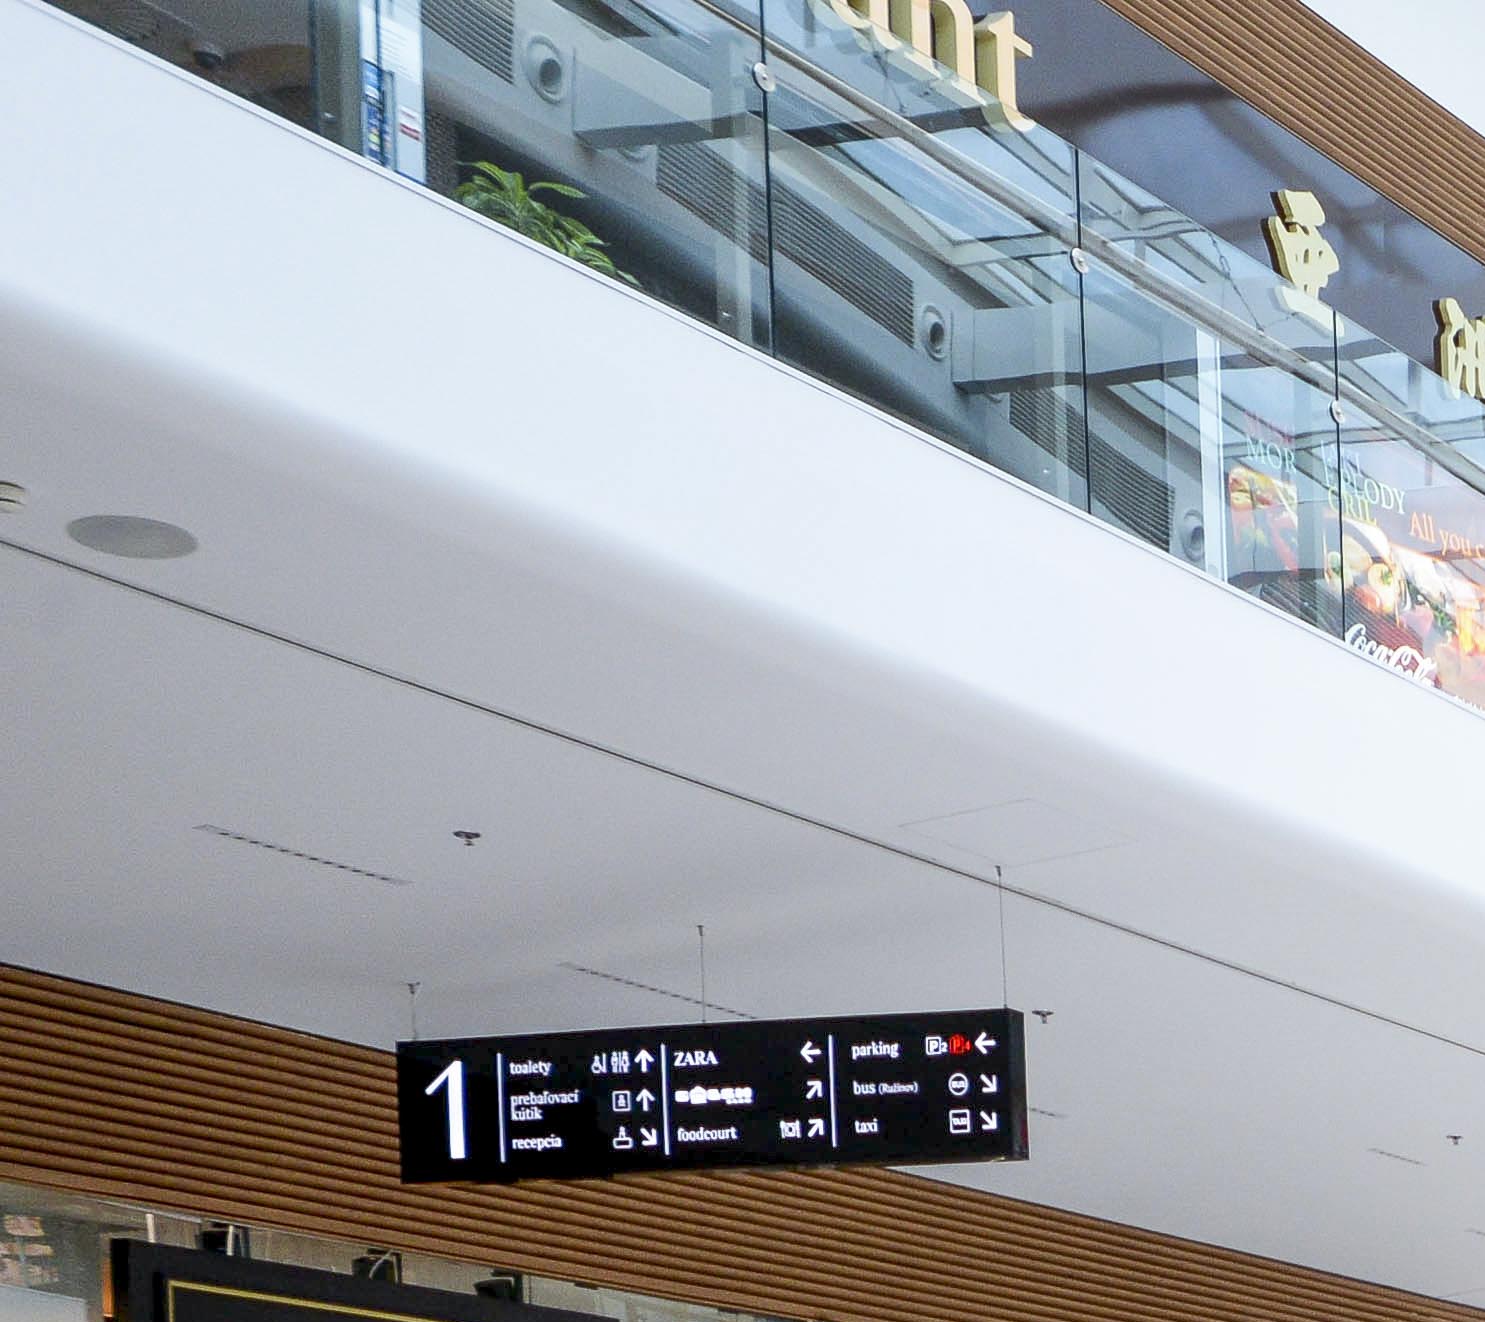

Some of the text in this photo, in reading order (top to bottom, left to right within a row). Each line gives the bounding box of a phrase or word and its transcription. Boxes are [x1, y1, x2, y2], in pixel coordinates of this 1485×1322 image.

[1409, 511, 1437, 544] All
[1439, 527, 1472, 558] you
[673, 1050, 718, 1067] ZARA
[852, 1040, 899, 1060] parking
[509, 1060, 552, 1077] toalety
[853, 1080, 876, 1095] bus
[425, 1060, 466, 1159] 1
[677, 1125, 738, 1142] foodcourt
[855, 1117, 878, 1134] taxi
[512, 1133, 562, 1152] recepcia
